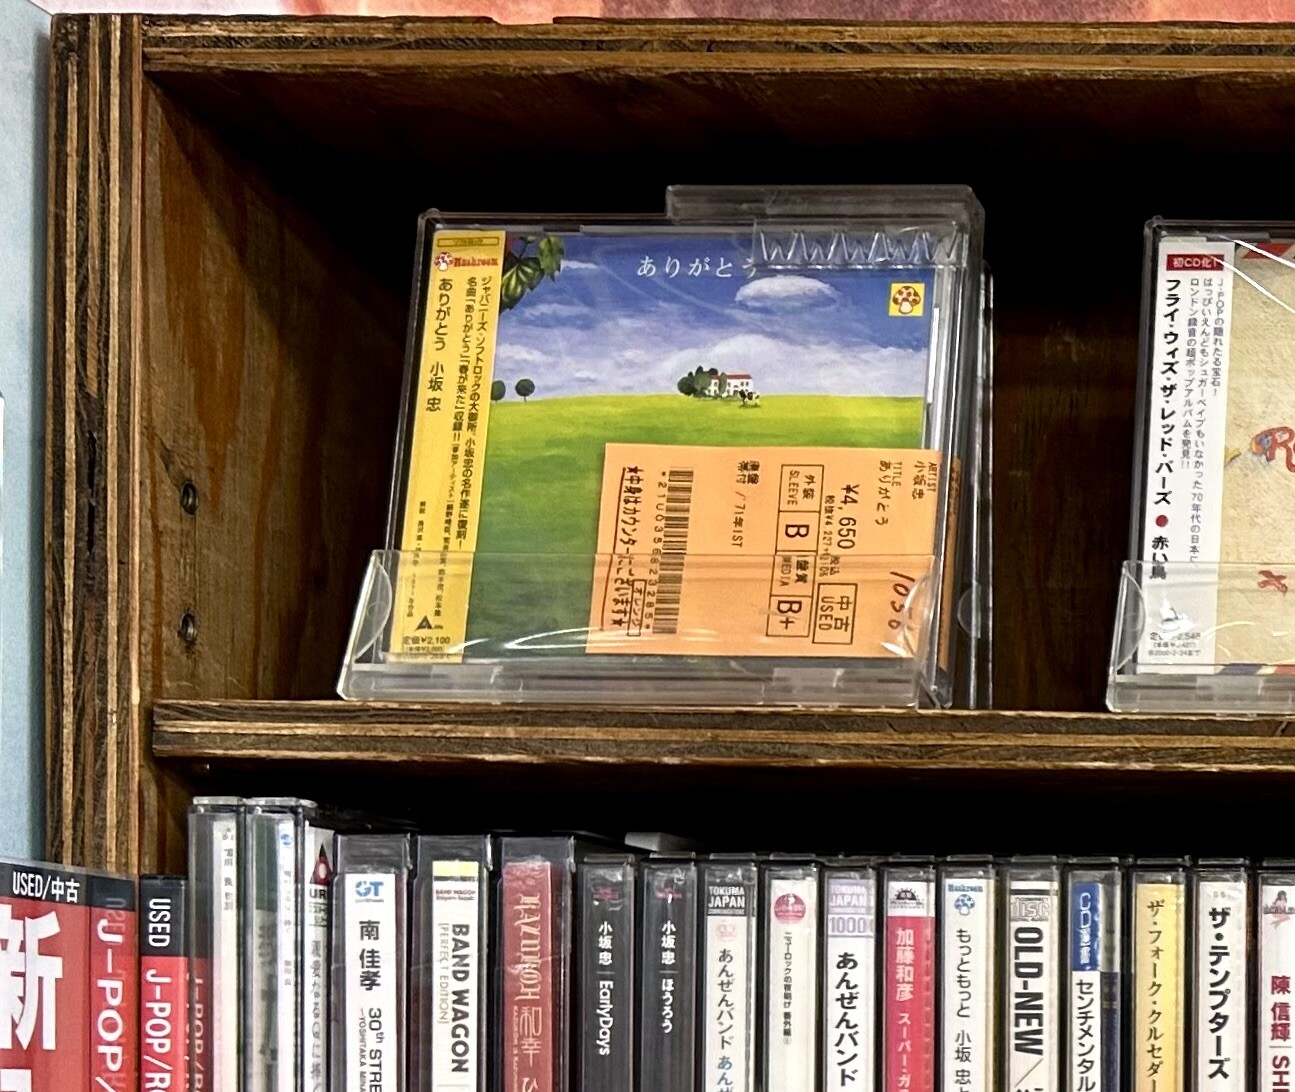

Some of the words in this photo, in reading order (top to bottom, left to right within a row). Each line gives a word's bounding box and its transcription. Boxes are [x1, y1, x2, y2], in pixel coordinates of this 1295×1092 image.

[434, 278, 453, 351] ありがとう
[787, 470, 799, 505] SLEEVE
[876, 460, 893, 526] ありがとう
[892, 462, 903, 487] TITLE
[785, 524, 809, 537] B
[818, 596, 834, 630] USED
[834, 596, 853, 632] 中古
[13, 870, 80, 903] USED/中古
[149, 896, 170, 949] USED
[598, 921, 613, 965] 小坂忠
[661, 921, 676, 965] 小坂忠
[452, 923, 470, 982] BAND
[897, 929, 914, 1002] 加藤和彦
[956, 930, 971, 1018] もっともっと
[661, 978, 673, 1034] ほうろう
[834, 951, 858, 1087] あんぜんバンド
[1013, 926, 1044, 1057] OLD-NEW
[1208, 906, 1232, 1080] ザ・テンプターズ
[451, 989, 470, 1073] WAGON
